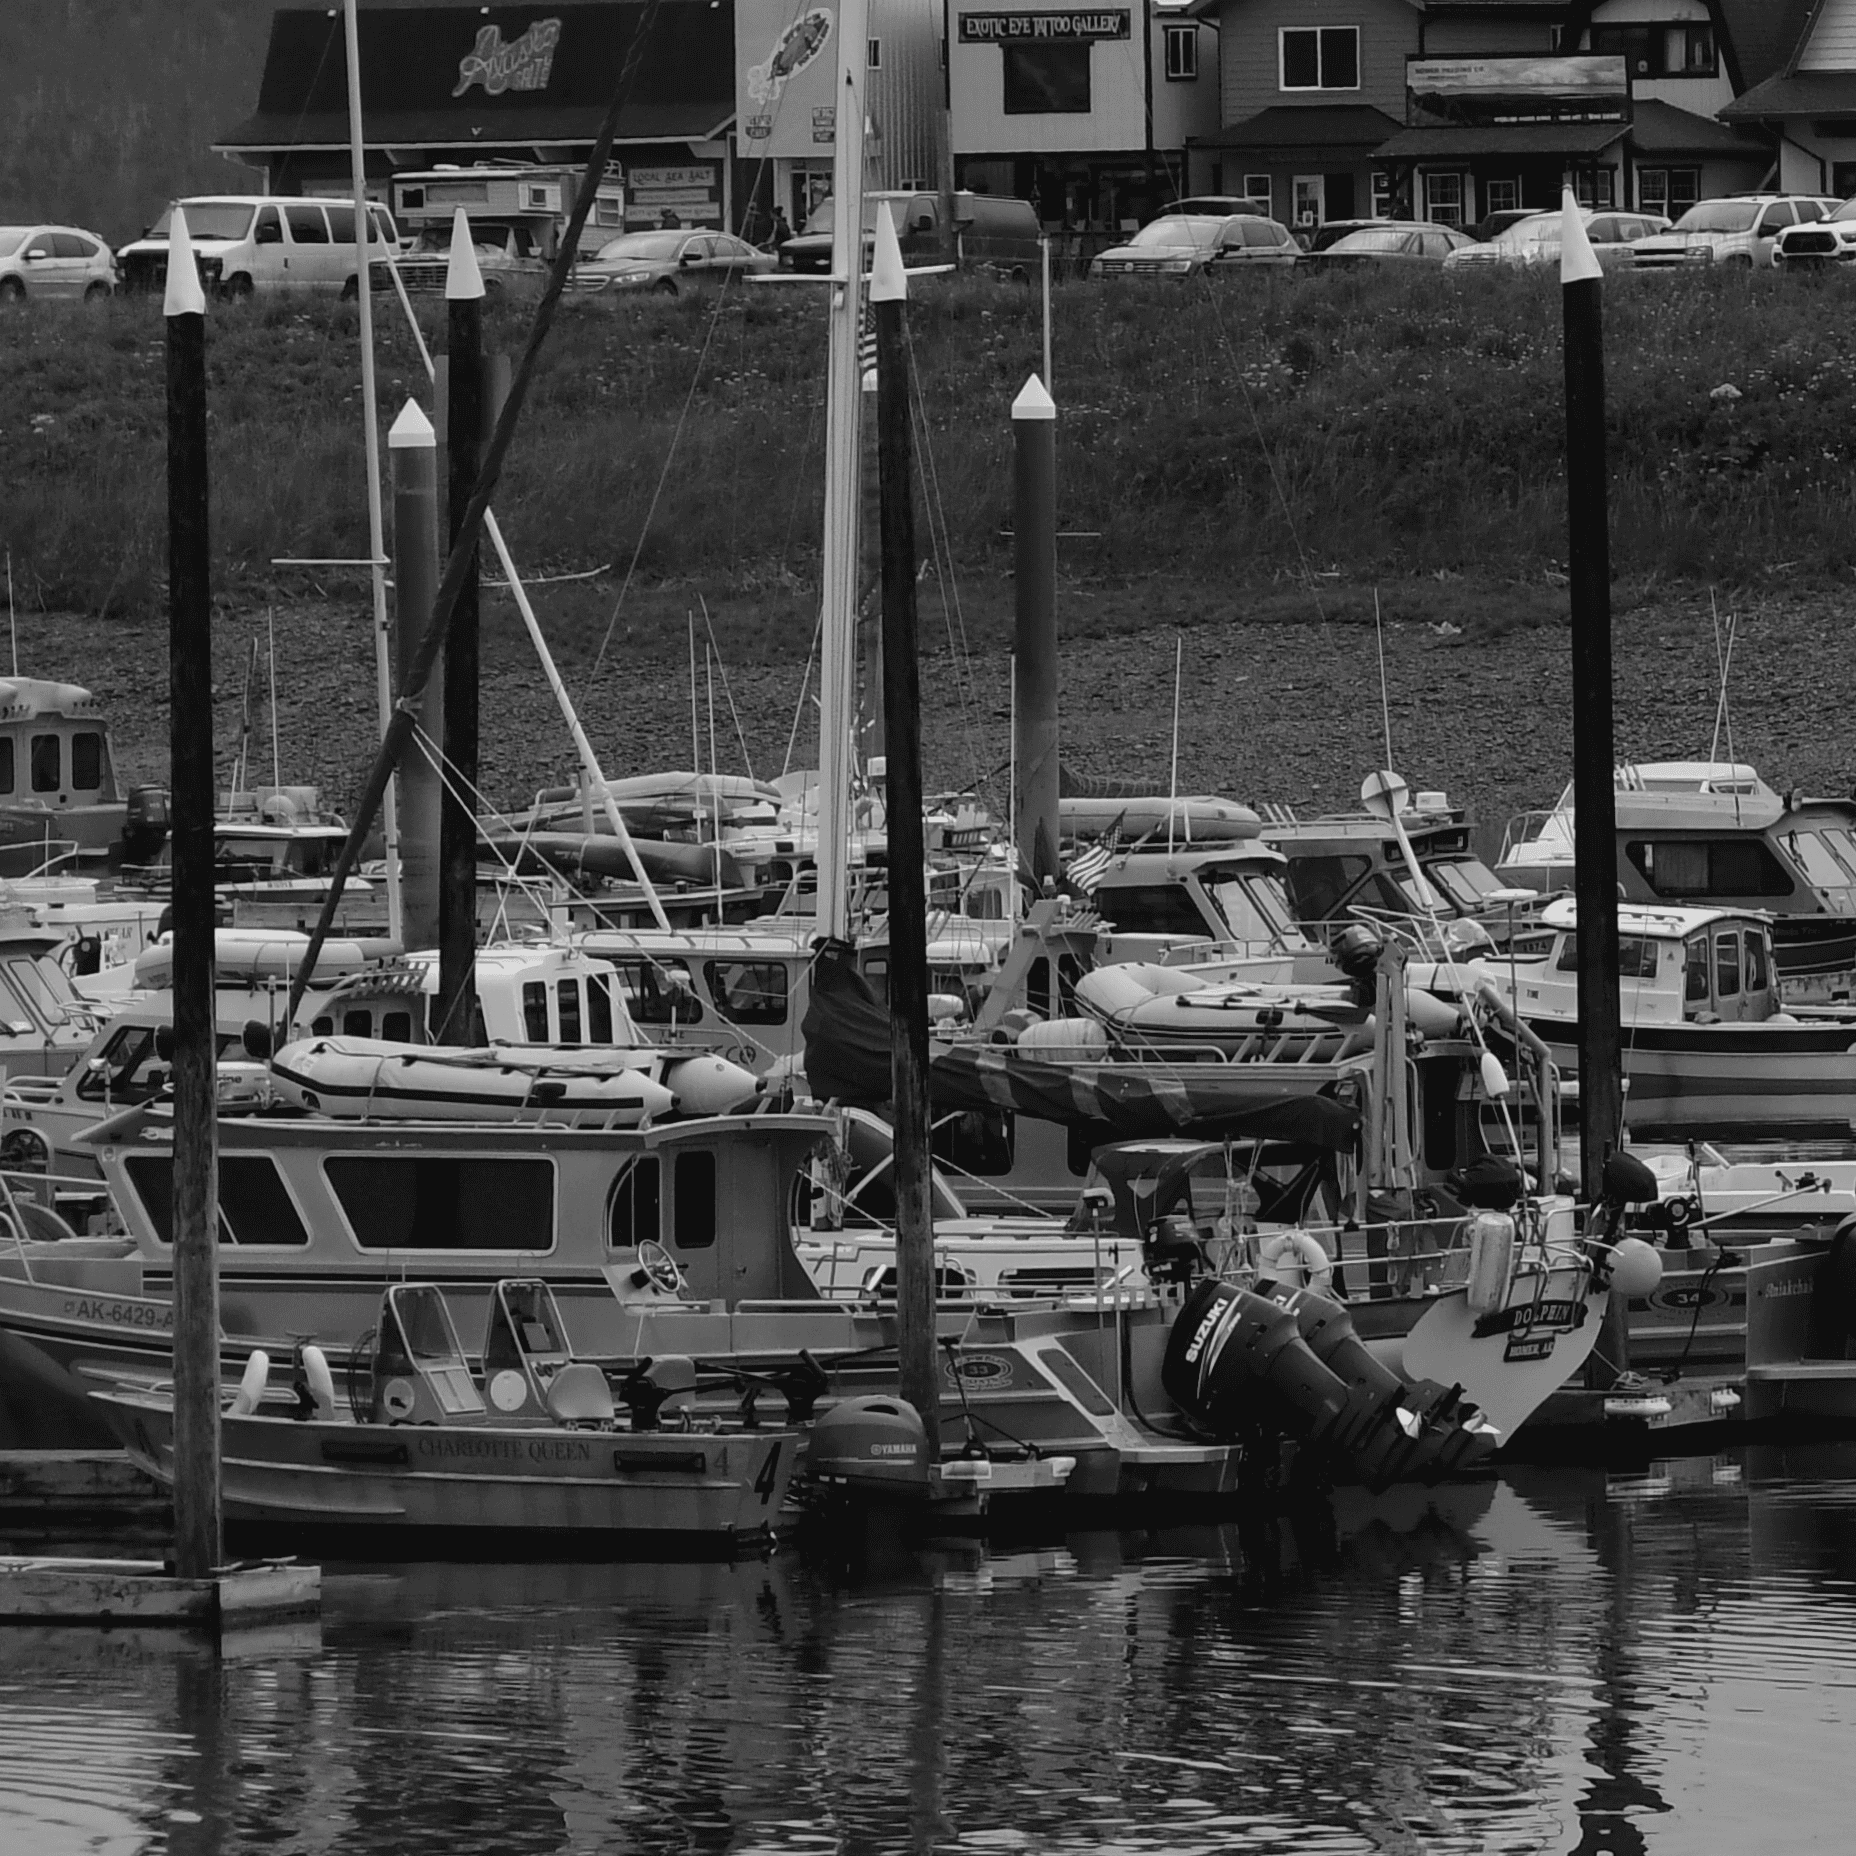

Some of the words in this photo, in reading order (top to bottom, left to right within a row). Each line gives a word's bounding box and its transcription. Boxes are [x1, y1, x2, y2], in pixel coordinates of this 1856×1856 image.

[966, 18, 1007, 37] EXOTIC
[1009, 18, 1031, 35] EYE
[1032, 16, 1071, 37] TATTOO
[1072, 14, 1121, 36] GALLERY
[1678, 1293, 1700, 1304] 34
[1512, 1304, 1571, 1327] DOLPHIN
[1185, 1297, 1229, 1363] SUZUKI
[969, 1365, 989, 1375] 33
[419, 1437, 524, 1460] CHARLOTTE
[528, 1442, 591, 1463] QUEEN
[883, 1444, 918, 1455] YAMAHA
[713, 1446, 730, 1478] 4
[754, 1441, 782, 1506] 4
